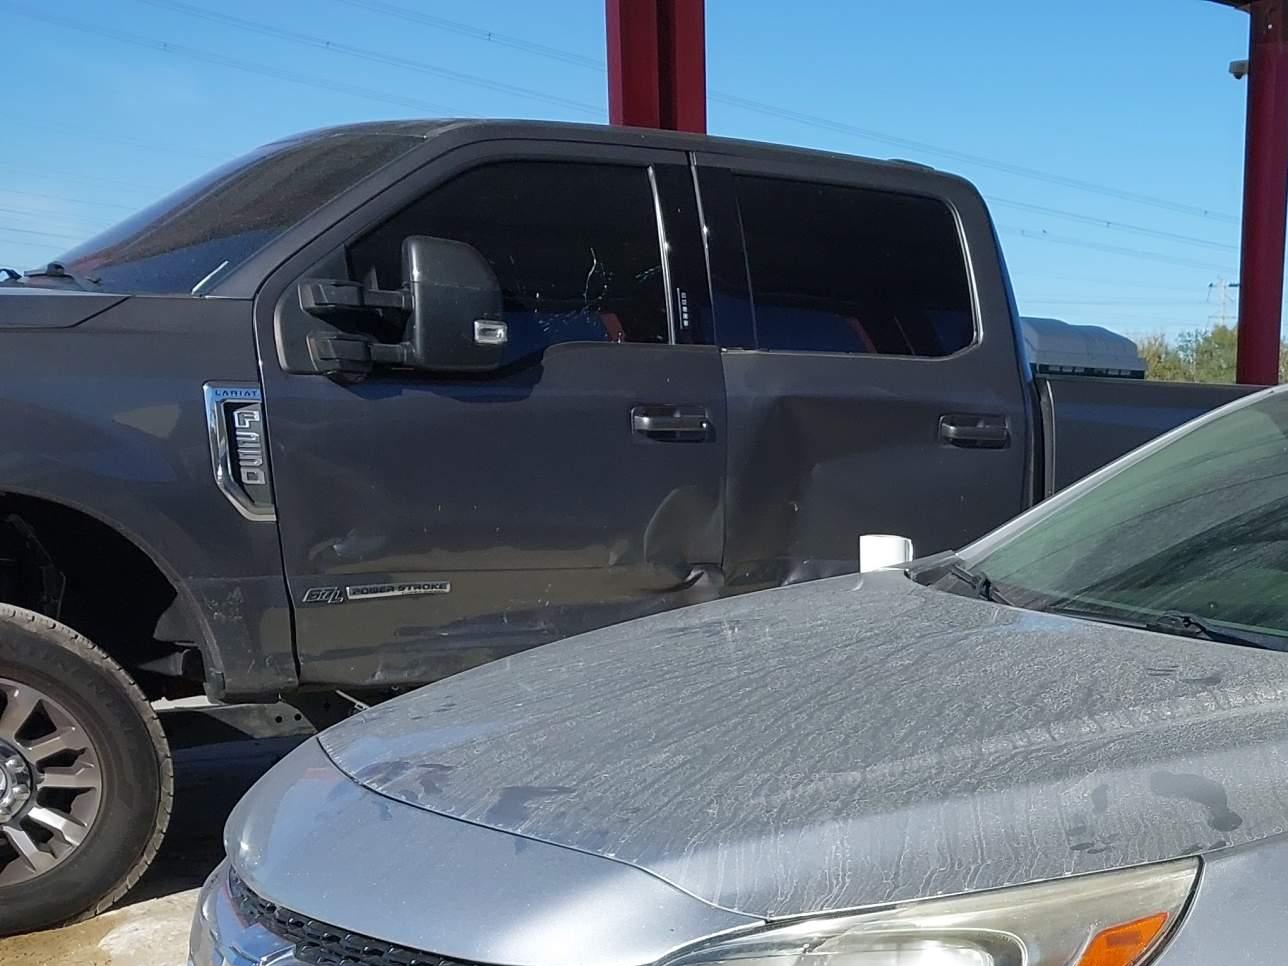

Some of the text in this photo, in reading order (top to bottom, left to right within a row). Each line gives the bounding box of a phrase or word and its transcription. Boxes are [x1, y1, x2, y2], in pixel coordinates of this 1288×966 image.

[214, 389, 258, 397] LARIAT
[351, 582, 448, 596] POWER STROKE
